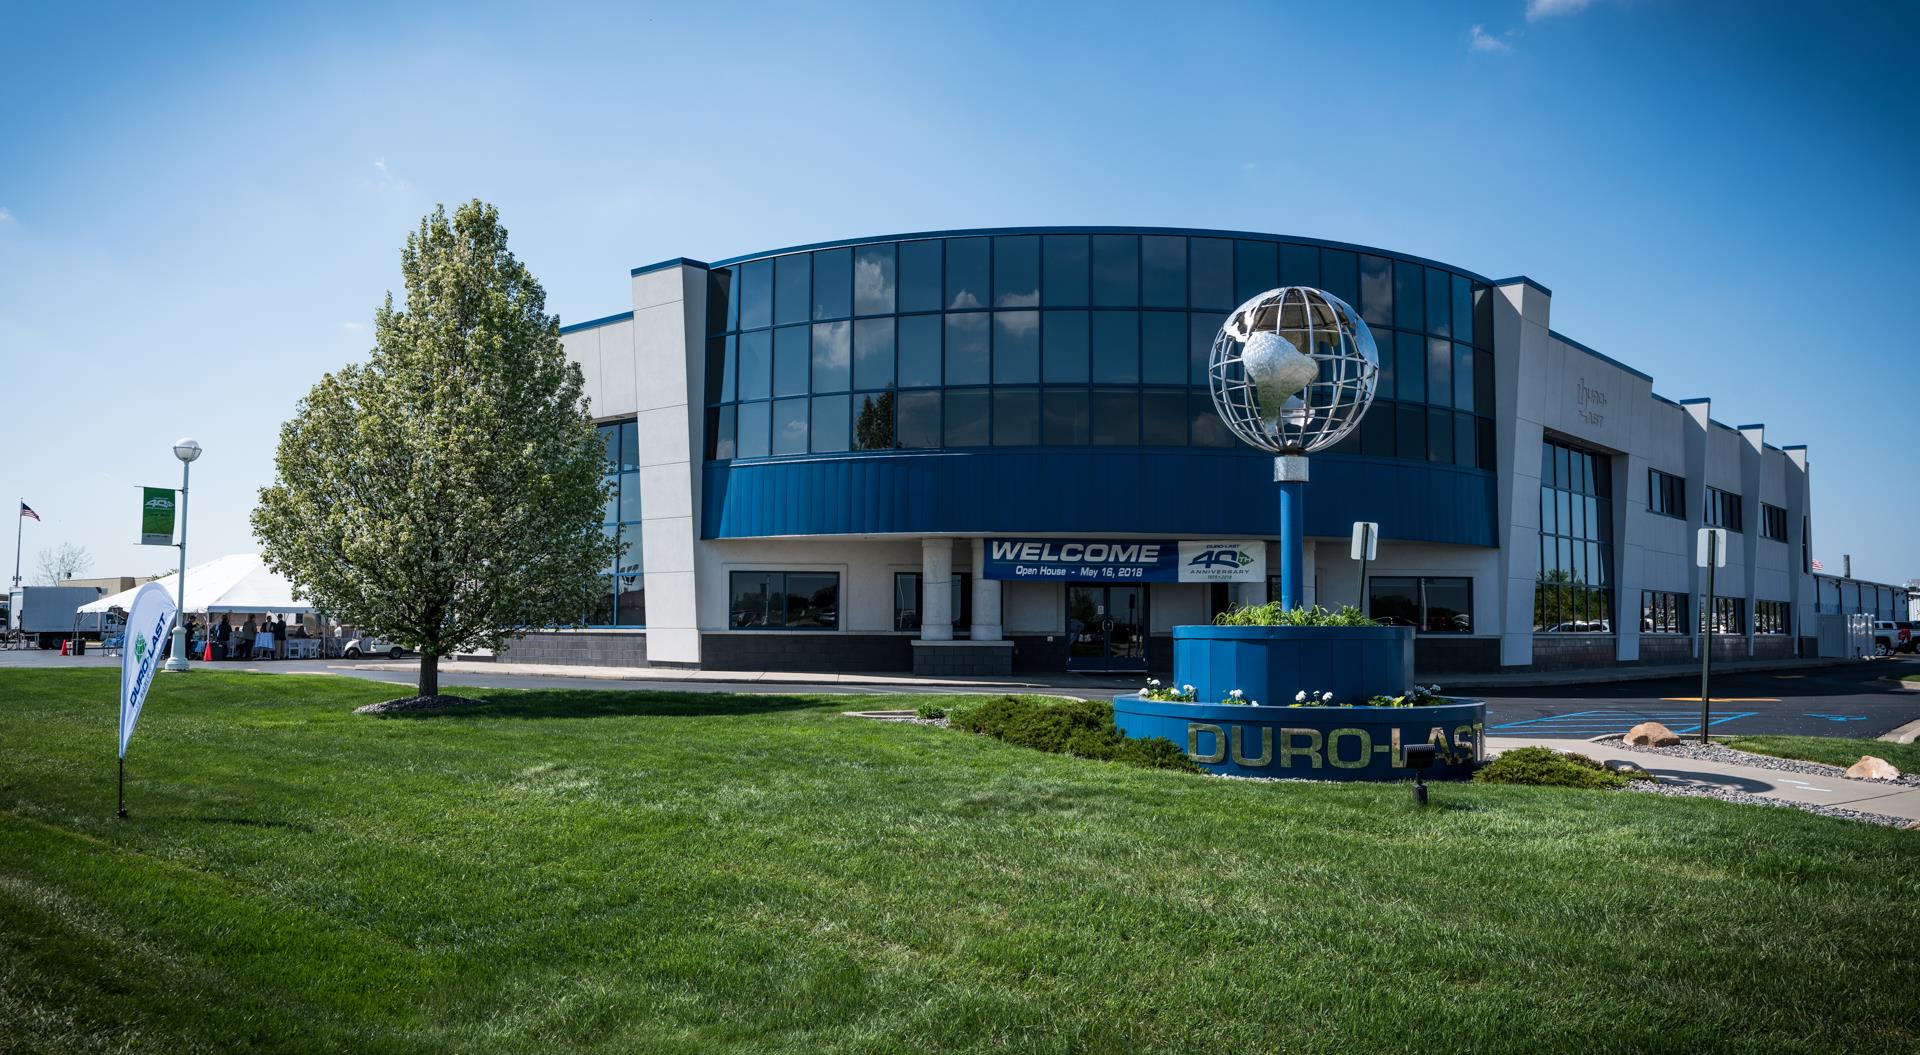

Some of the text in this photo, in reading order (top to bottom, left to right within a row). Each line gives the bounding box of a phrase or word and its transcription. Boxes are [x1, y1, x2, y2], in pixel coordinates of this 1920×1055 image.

[992, 541, 1161, 562] WELCOME
[1016, 565, 1037, 576] Open
[1040, 566, 1066, 576] House
[1080, 567, 1098, 578] May
[1102, 567, 1115, 579] 16,
[1118, 568, 1143, 577] 2018
[1187, 722, 1483, 769] DURO-LAST
